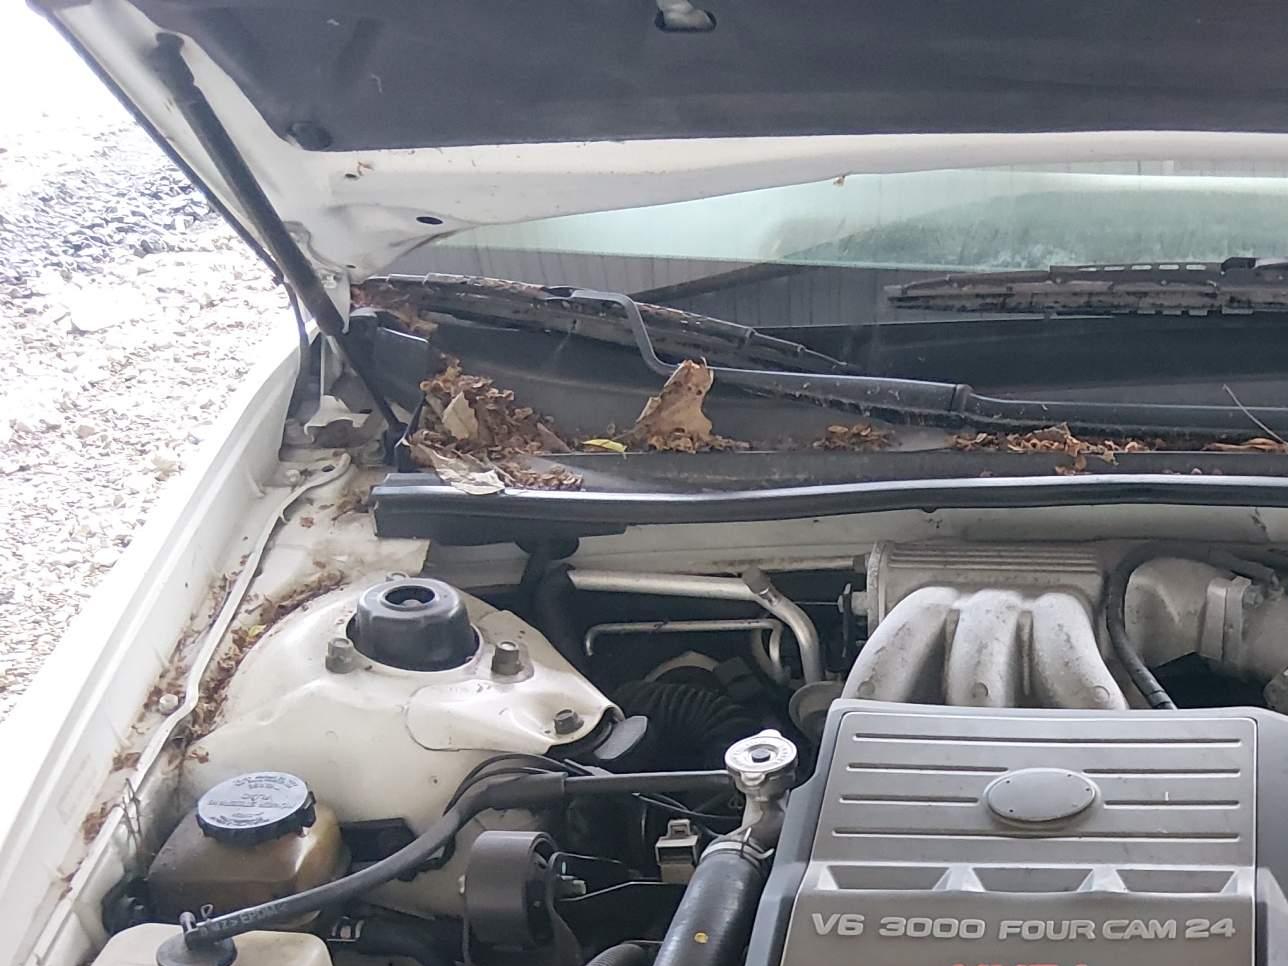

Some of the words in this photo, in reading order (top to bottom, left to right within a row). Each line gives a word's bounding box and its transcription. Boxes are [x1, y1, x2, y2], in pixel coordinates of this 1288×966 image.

[811, 912, 865, 936] V6
[879, 916, 986, 939] 3000
[998, 919, 1097, 940] FOUR
[1102, 919, 1178, 939] CAM
[1185, 918, 1236, 939] 24
